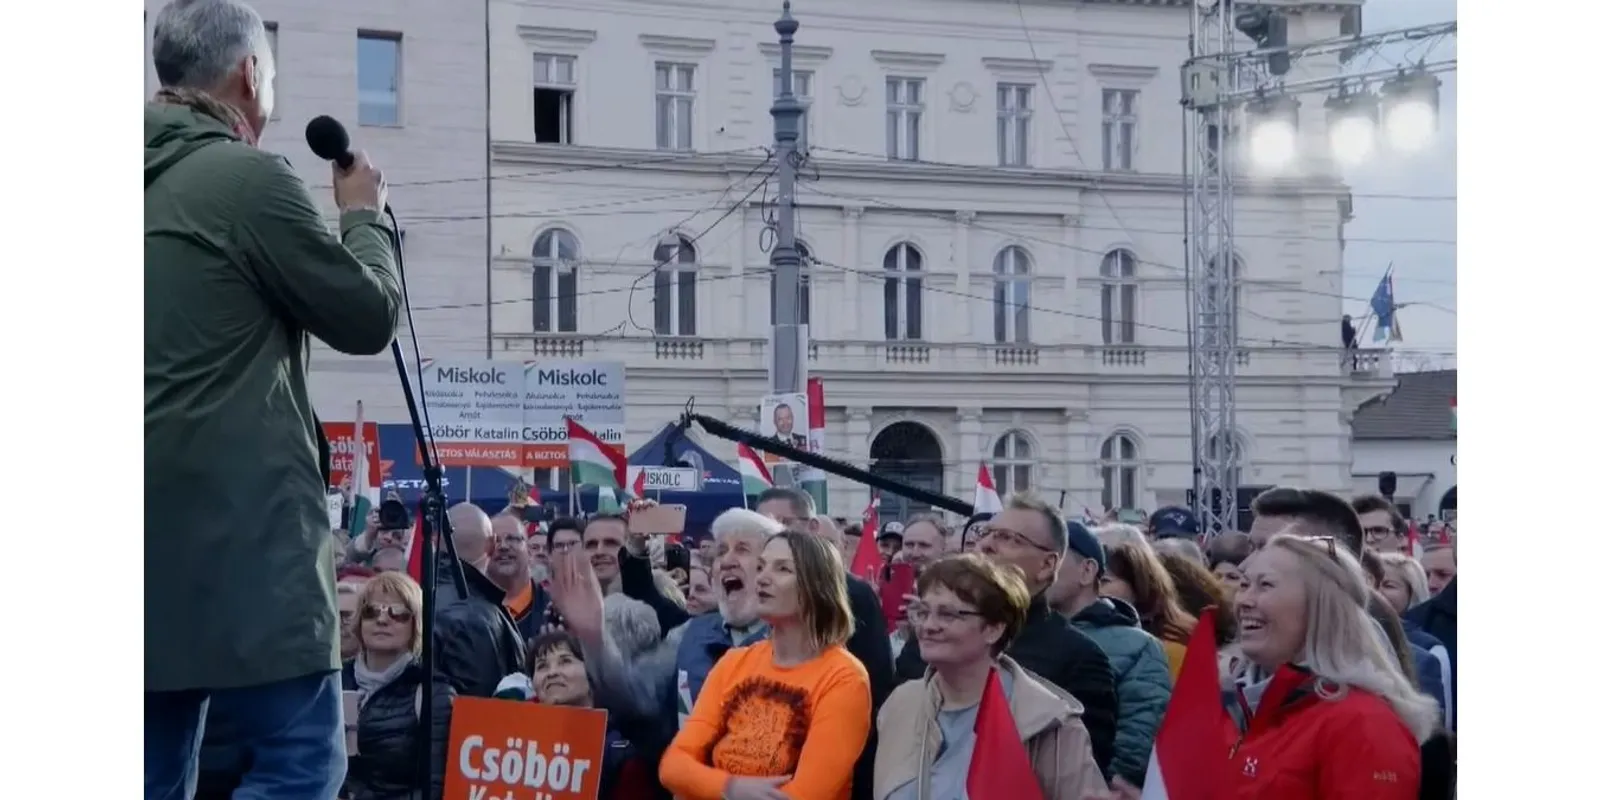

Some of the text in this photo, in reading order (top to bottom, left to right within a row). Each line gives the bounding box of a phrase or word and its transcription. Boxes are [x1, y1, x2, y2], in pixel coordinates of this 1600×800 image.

[437, 367, 506, 384] Miskolc
[538, 368, 607, 386] Miskolc
[475, 427, 519, 440] Katalin
[327, 436, 375, 455] söbr
[464, 447, 517, 460] VÁLASZTÁS
[525, 450, 567, 460] A BIZTOS
[643, 471, 681, 486] ISKOLC
[459, 734, 592, 793] Csöbör
